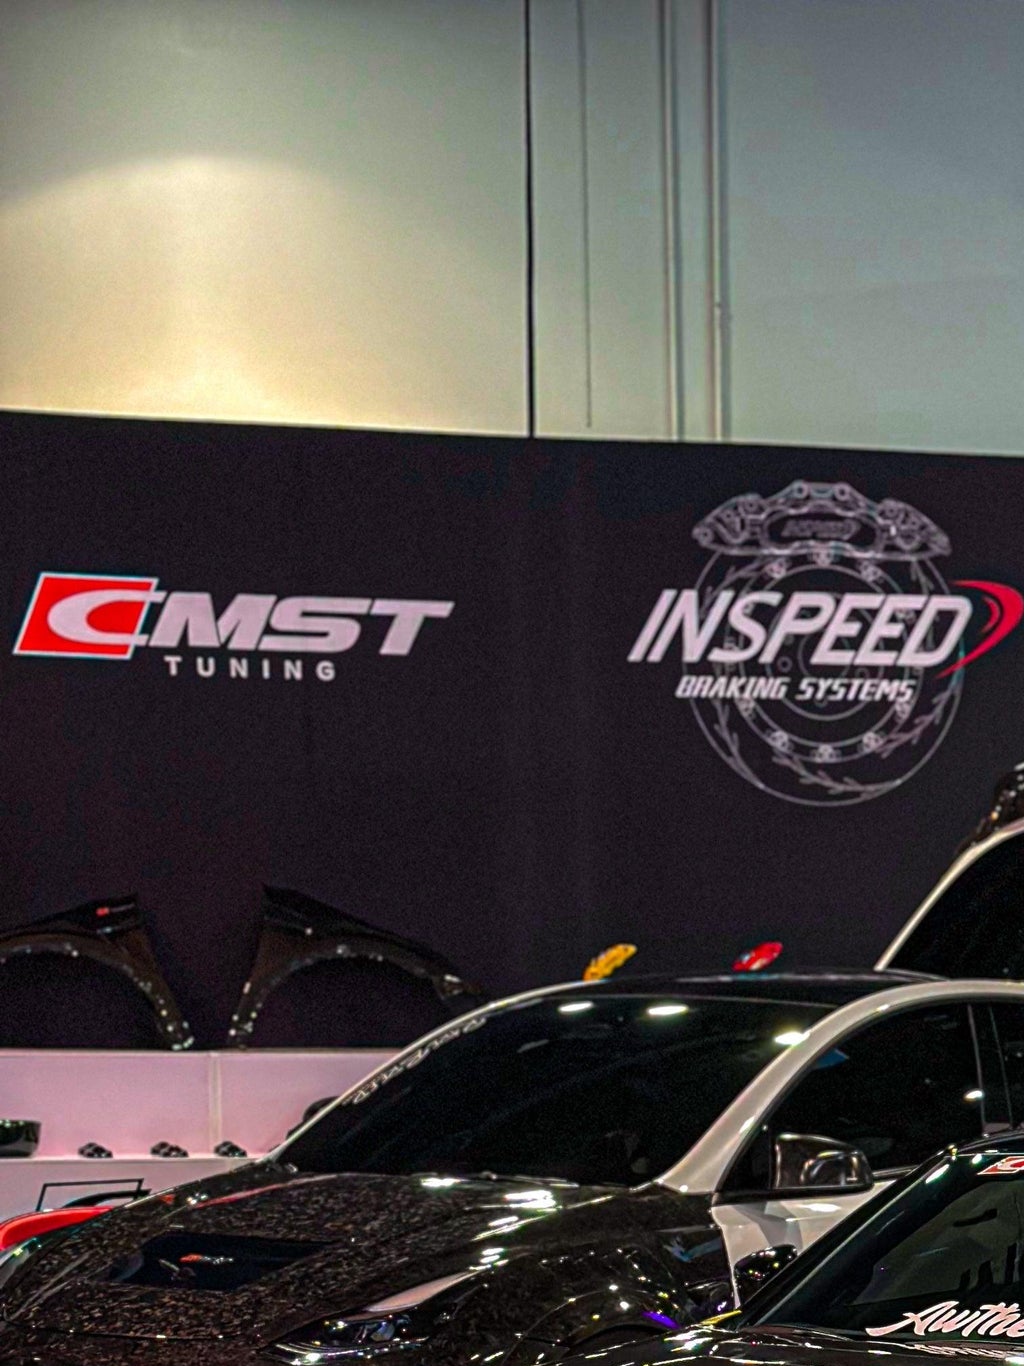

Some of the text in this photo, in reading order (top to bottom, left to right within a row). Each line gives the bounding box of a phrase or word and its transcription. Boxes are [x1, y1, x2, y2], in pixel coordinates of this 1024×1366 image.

[46, 587, 455, 656] CMST
[628, 589, 973, 668] INSPEED
[164, 655, 336, 682] TUNING
[675, 675, 916, 703] BRAKING SYSTEMS
